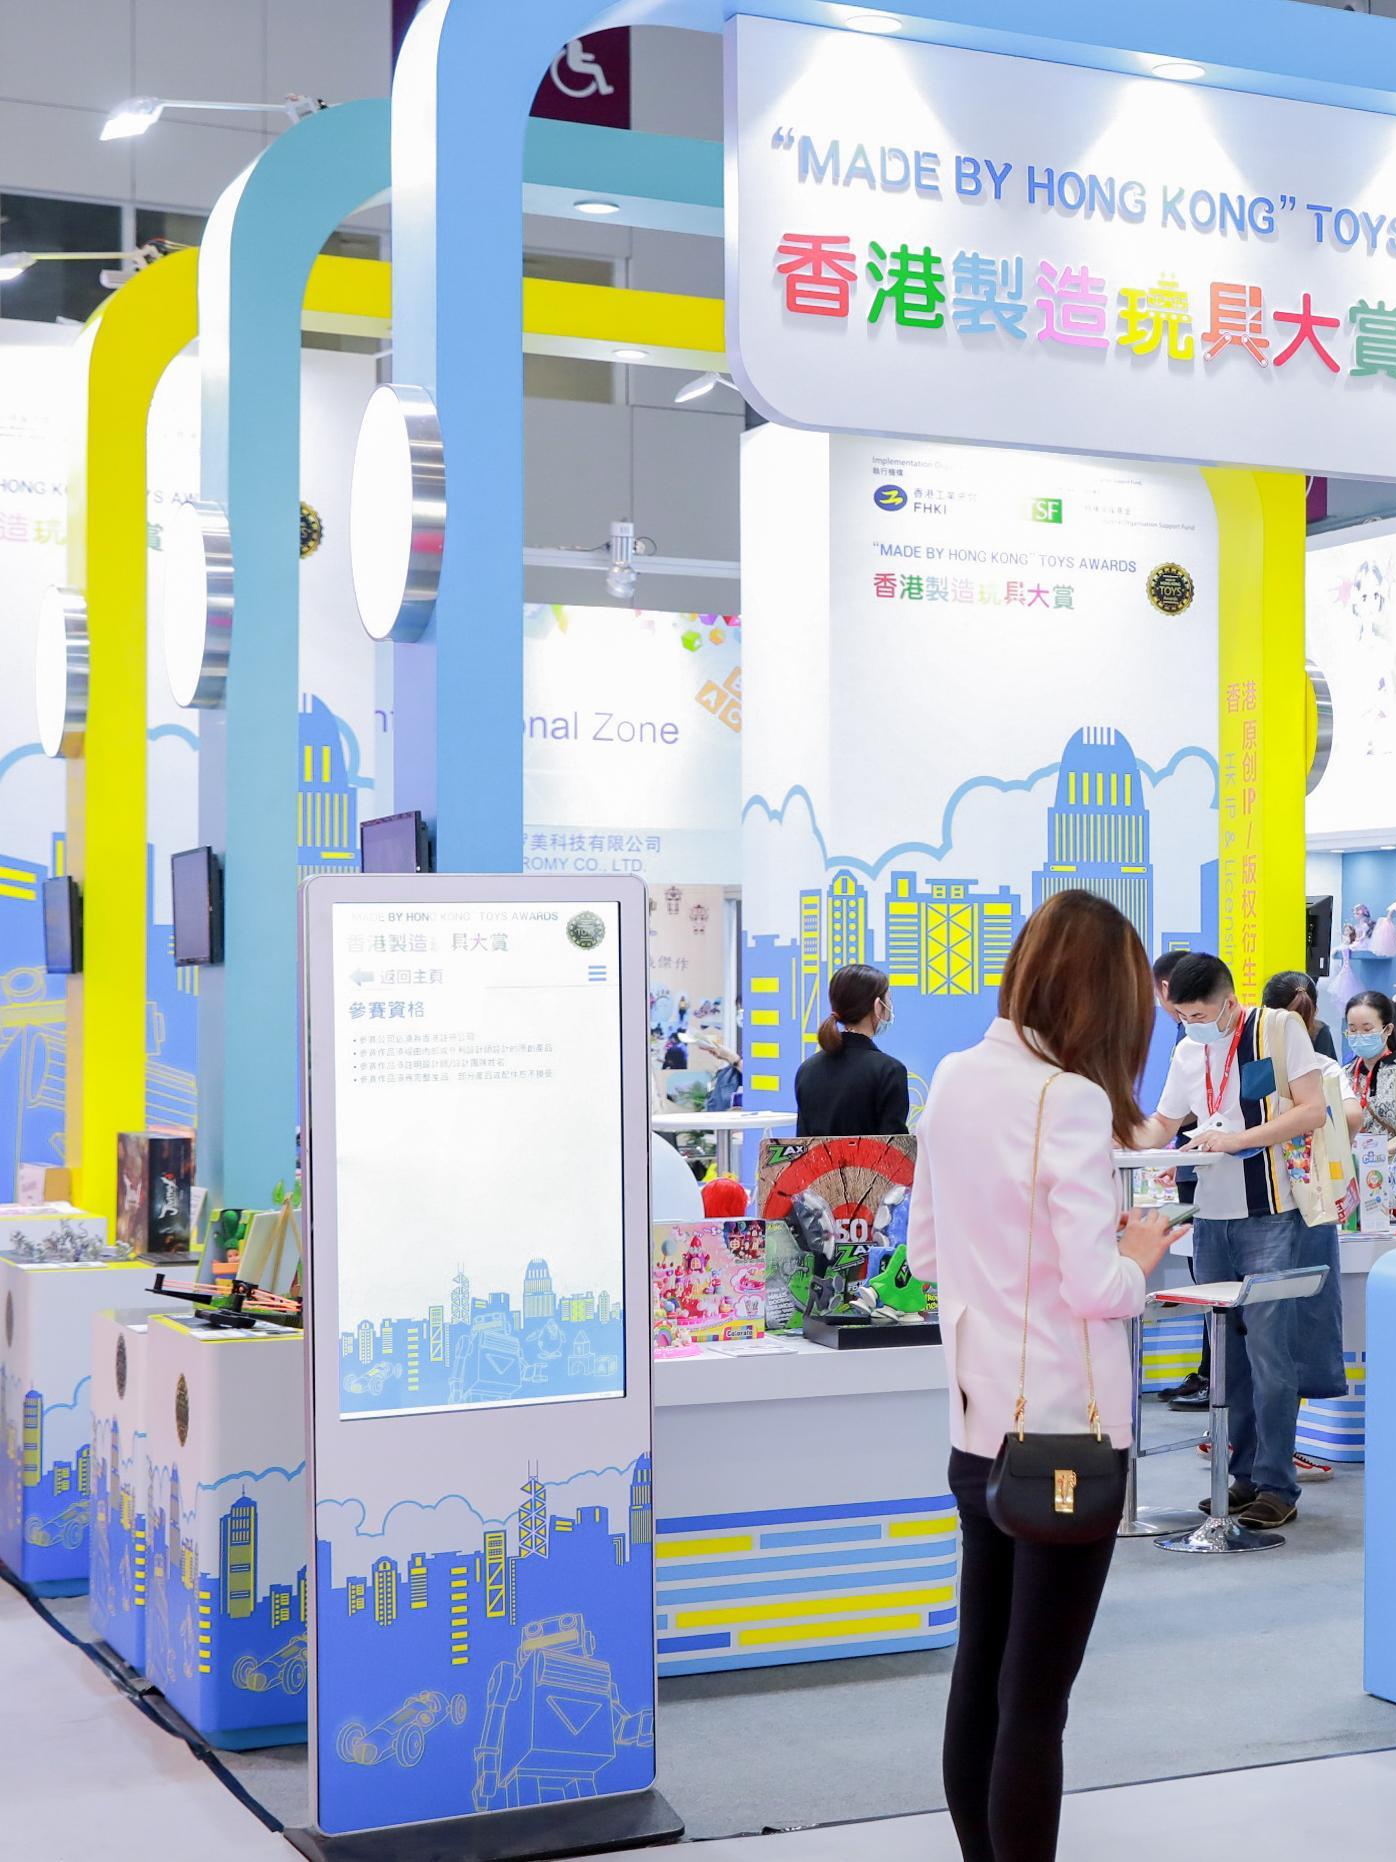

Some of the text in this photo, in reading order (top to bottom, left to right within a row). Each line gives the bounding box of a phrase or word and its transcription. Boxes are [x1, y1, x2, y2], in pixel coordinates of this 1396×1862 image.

[771, 126, 941, 192] “MADE
[954, 155, 1013, 201] BY
[1026, 164, 1147, 220] HONG
[1162, 184, 1297, 236] KONG”
[913, 501, 947, 514] FHKI
[925, 545, 945, 560] BY
[948, 548, 988, 564] HONG
[1038, 553, 1075, 570] TOYS
[1078, 557, 1137, 574] AWARDS
[873, 572, 1076, 611] 香港製造玩具大賞
[1159, 585, 1182, 597] TOYS
[1226, 680, 1257, 714] 香港
[522, 709, 681, 745] nal Zone
[611, 858, 647, 873] LTD.
[387, 911, 404, 922] BY
[479, 911, 508, 922] TOYS
[511, 911, 559, 922] AWARDS
[347, 932, 512, 954] 香港製造具大賞
[380, 968, 445, 986] 返回主頁
[348, 1000, 425, 1020] 參賽資格
[767, 1144, 805, 1166] ZAX
[834, 1218, 869, 1244] 50
[727, 1329, 753, 1338] Colorato
